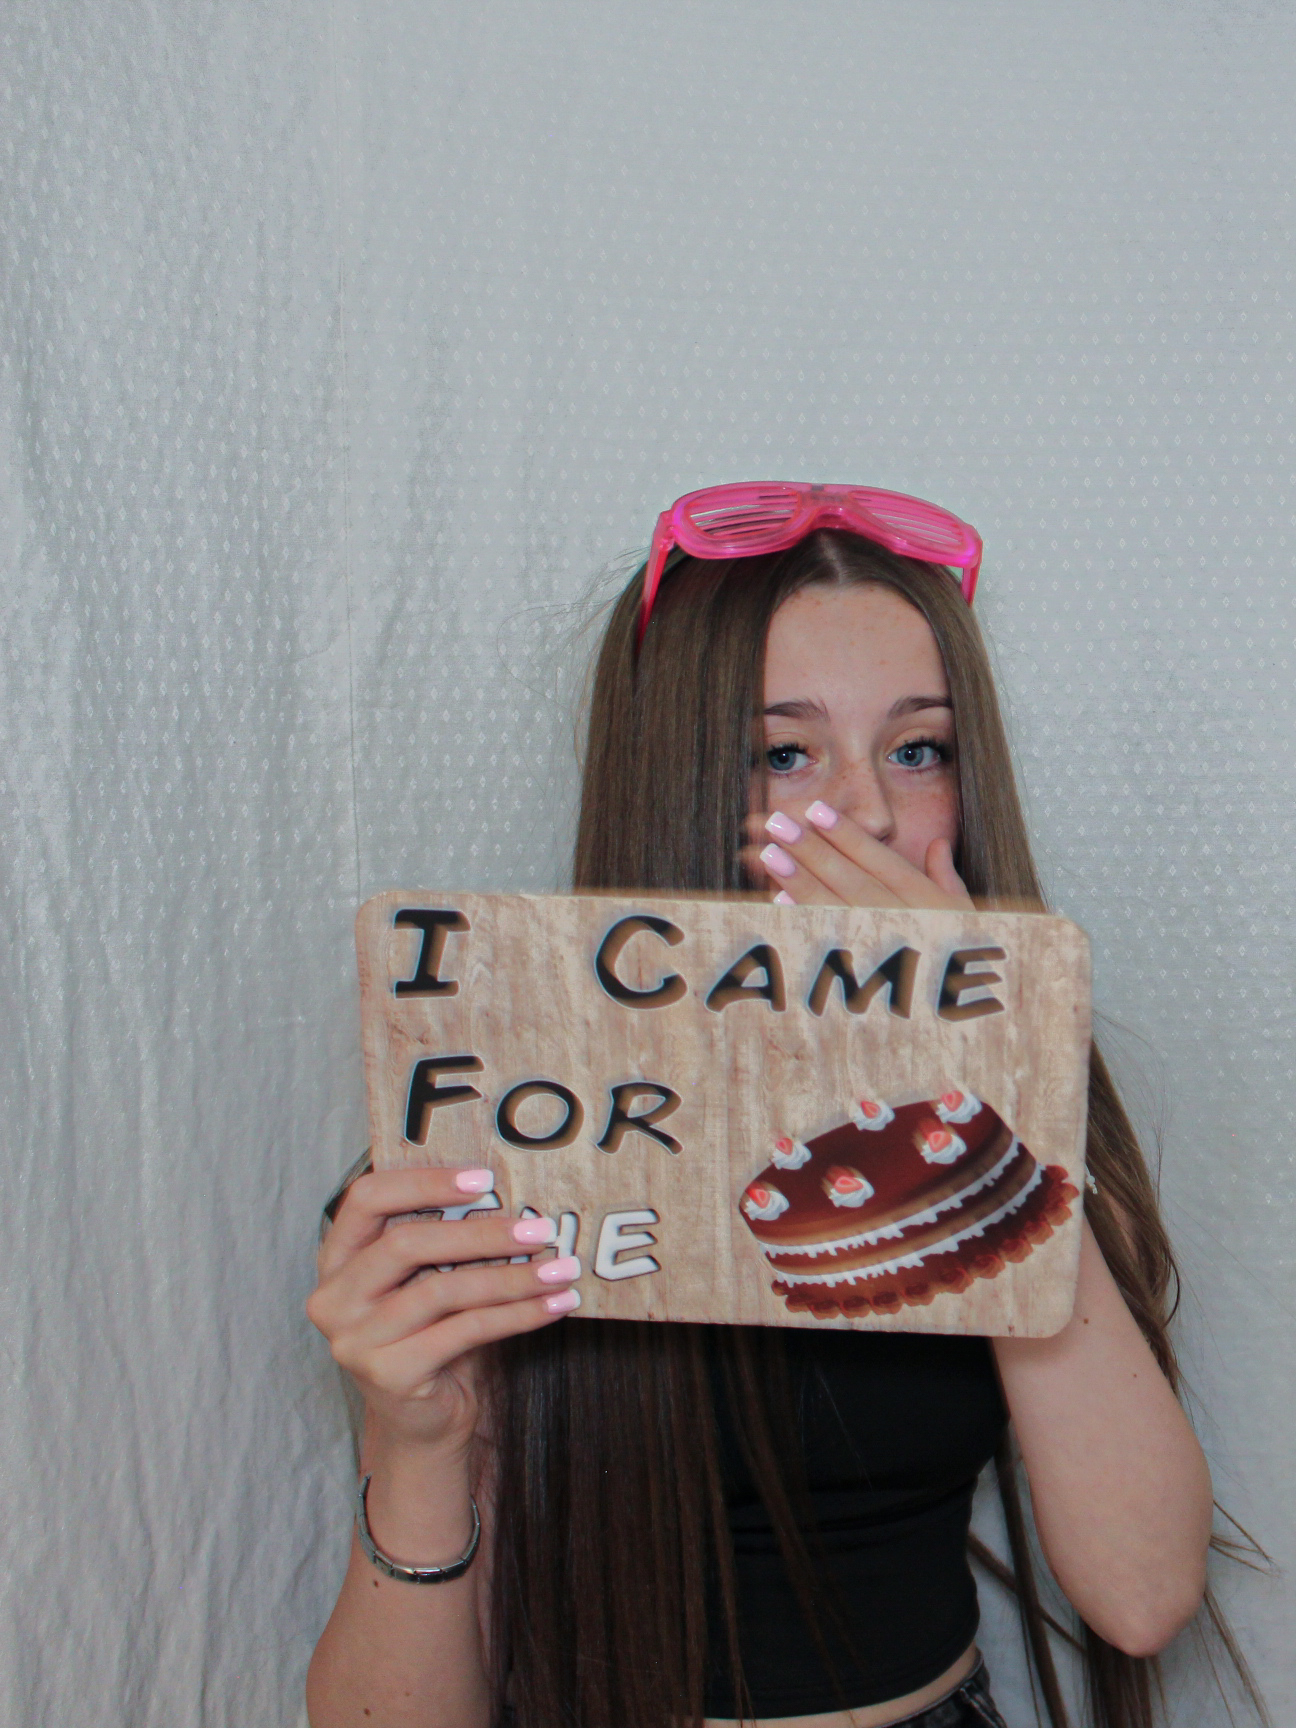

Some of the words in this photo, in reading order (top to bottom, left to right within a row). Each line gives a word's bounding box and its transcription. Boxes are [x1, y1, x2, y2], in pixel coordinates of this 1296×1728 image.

[392, 907, 471, 1000] I
[594, 914, 1007, 1022] CAME
[404, 1055, 684, 1156] FOR
